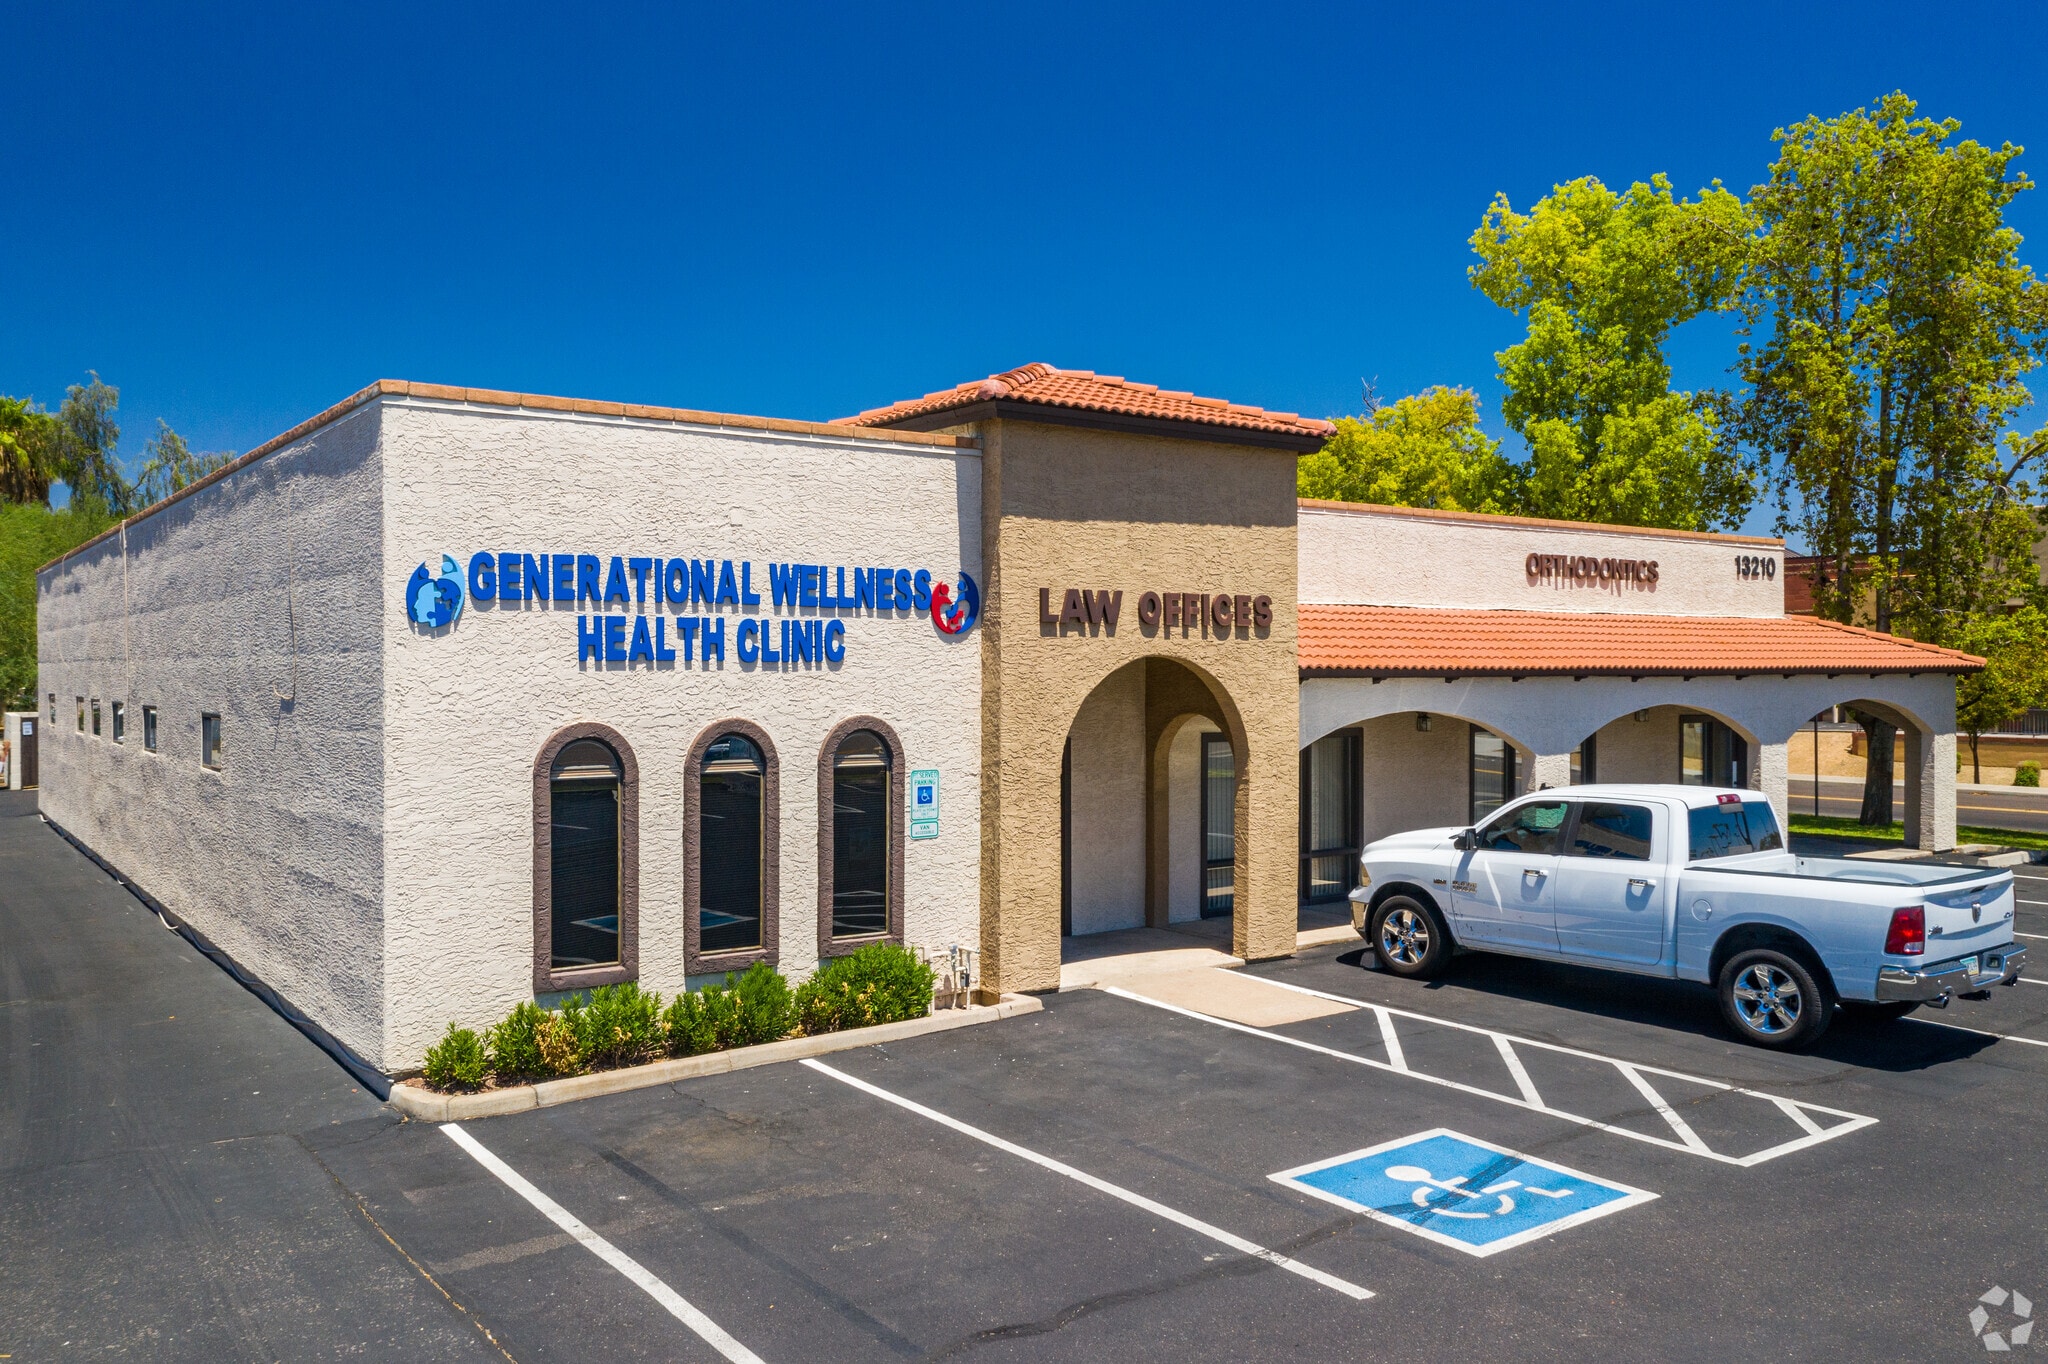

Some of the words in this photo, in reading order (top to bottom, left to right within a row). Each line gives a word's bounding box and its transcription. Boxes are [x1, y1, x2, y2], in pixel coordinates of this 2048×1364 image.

[468, 551, 760, 605] GENERATIONAL
[769, 563, 932, 611] WELLNESS
[1525, 552, 1660, 583] ORTHODONTICS
[1735, 555, 1776, 578] 13210
[1039, 587, 1123, 624] LAW
[1138, 591, 1273, 627] OFFICES
[578, 615, 725, 662] HEALTH
[737, 618, 846, 663] CLINIC
